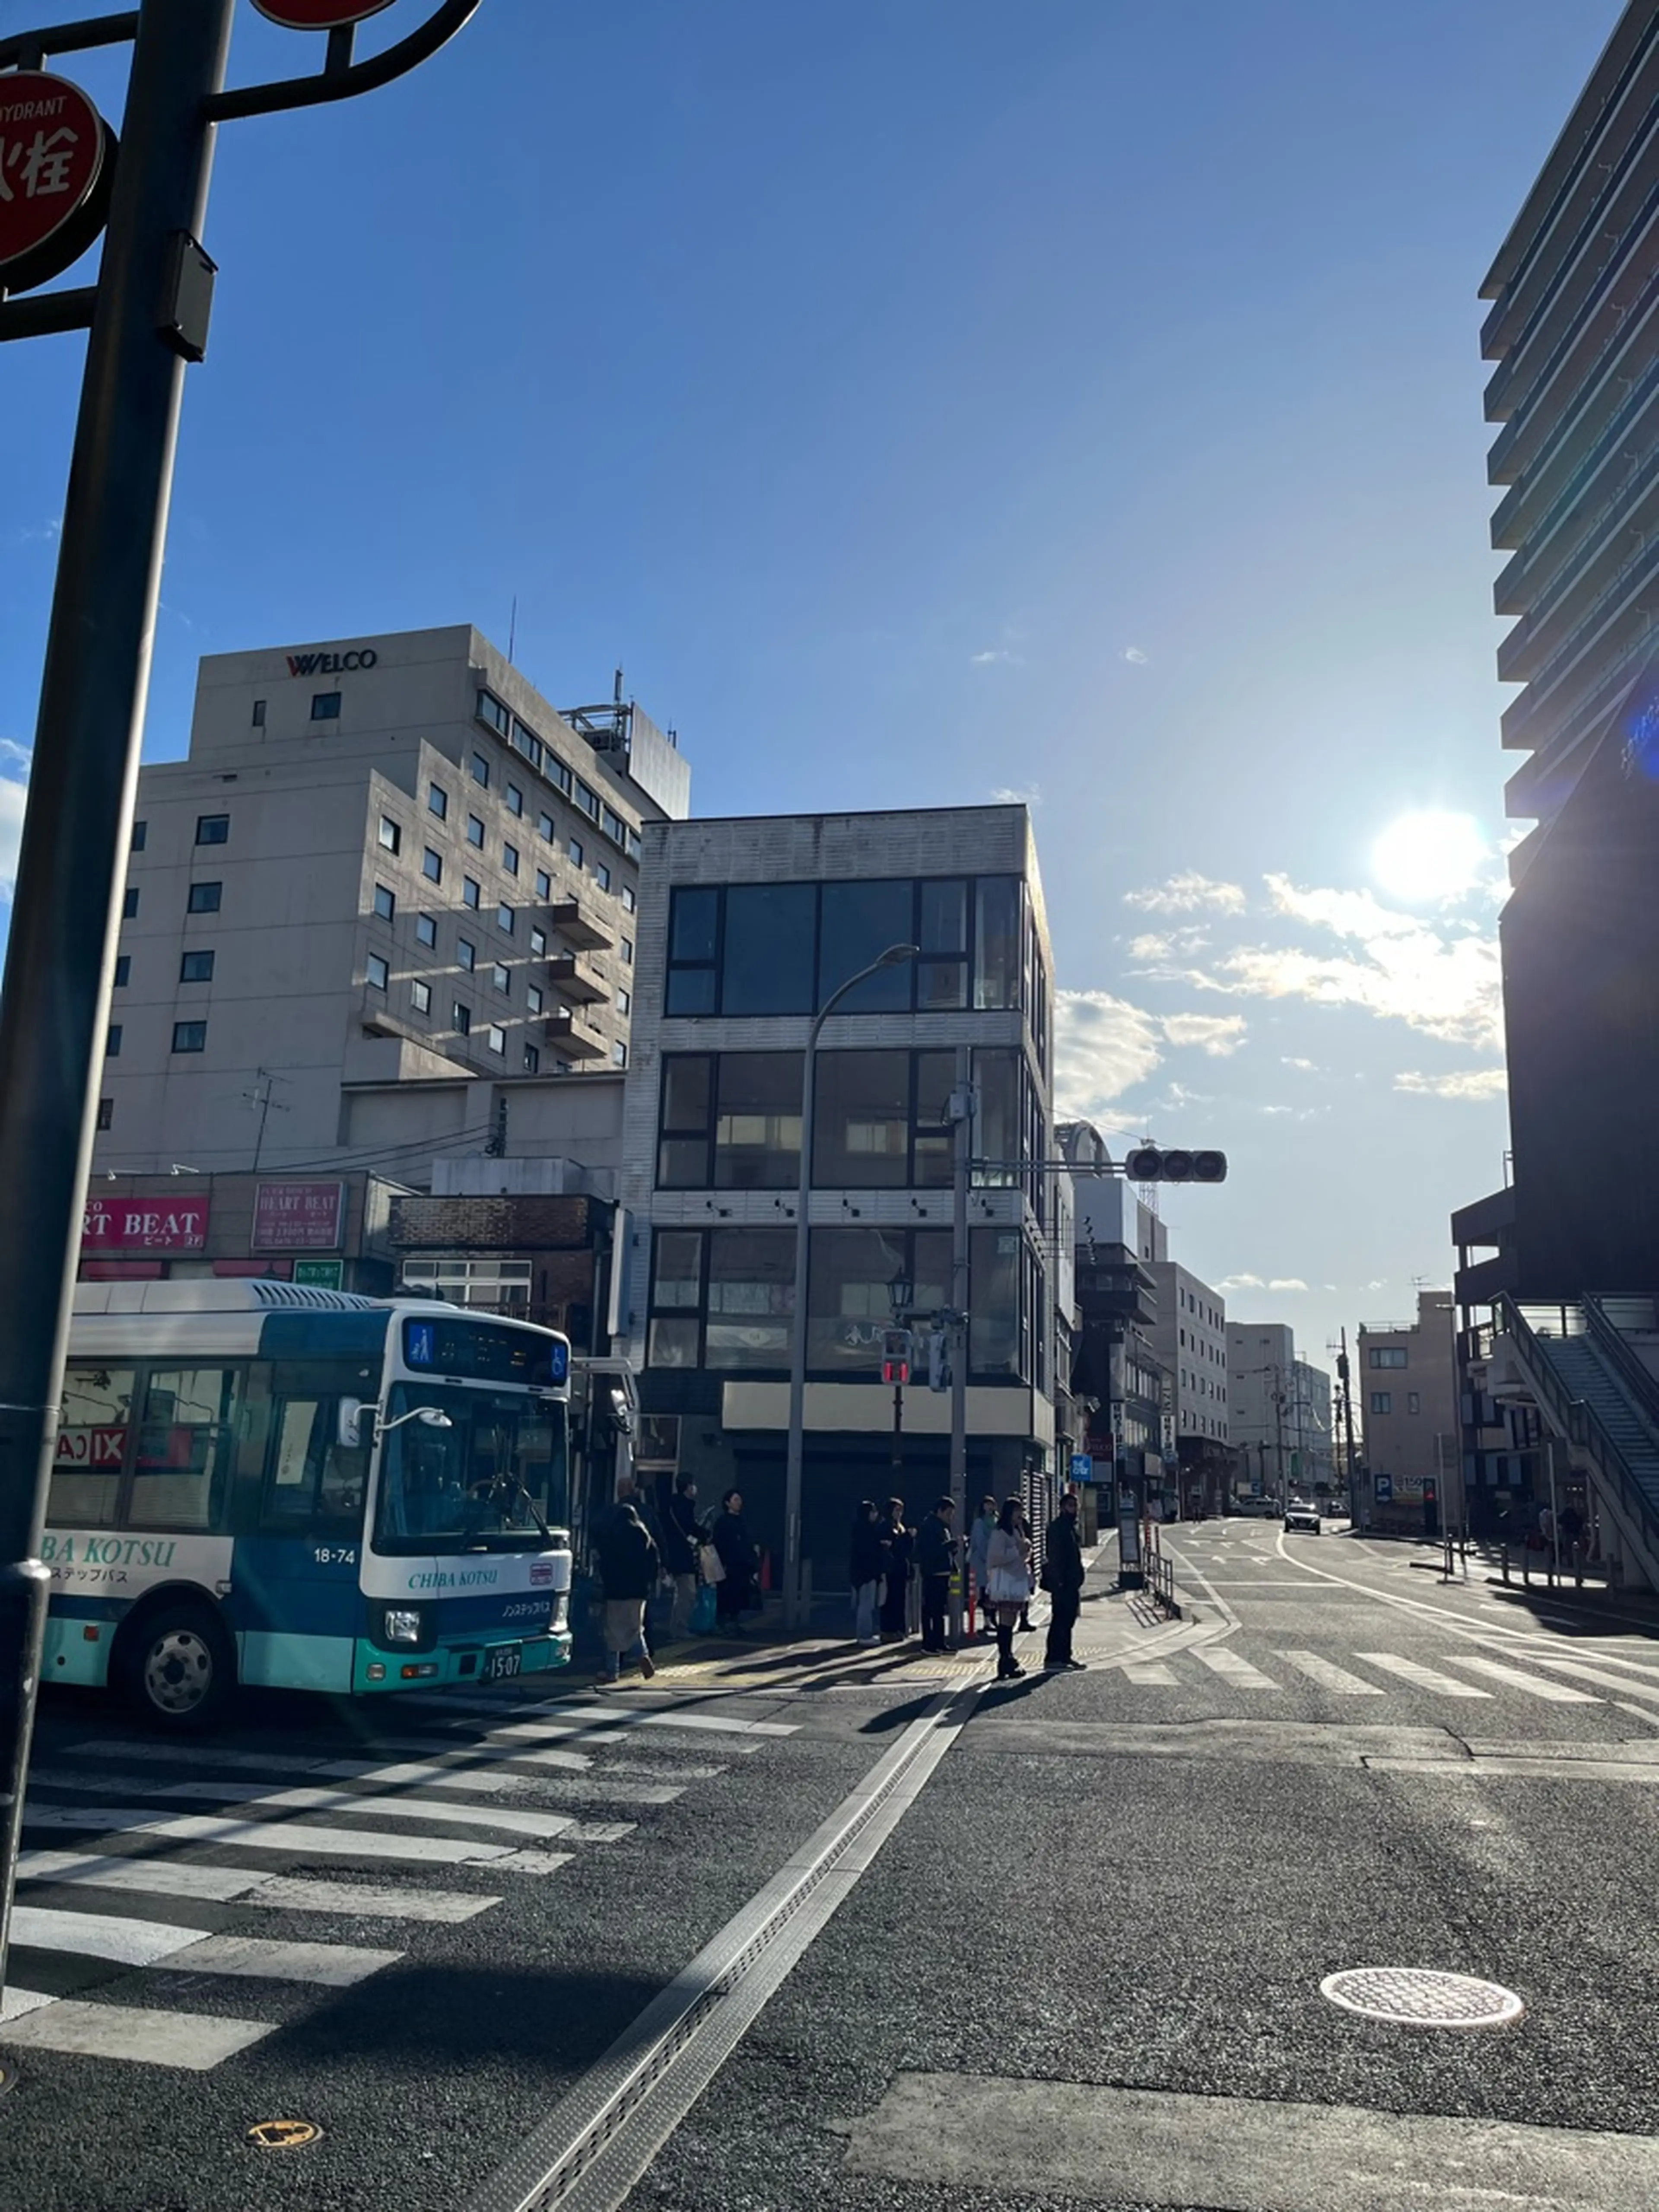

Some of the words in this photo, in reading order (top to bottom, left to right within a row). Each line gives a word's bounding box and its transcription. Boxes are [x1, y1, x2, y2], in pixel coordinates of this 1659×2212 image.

[0, 95, 67, 123] YDRANT
[260, 1195, 300, 1210] HEART
[305, 1195, 336, 1210] BEAT
[123, 1212, 200, 1235] BEAT
[143, 1236, 173, 1246] ビート
[1377, 1477, 1390, 1492] P
[83, 1538, 177, 1567] KOTSU
[314, 1547, 355, 1564] 18-74
[51, 1566, 127, 1583] ステップバス
[408, 1572, 454, 1589] CHIBA
[458, 1570, 498, 1586] KOTSU
